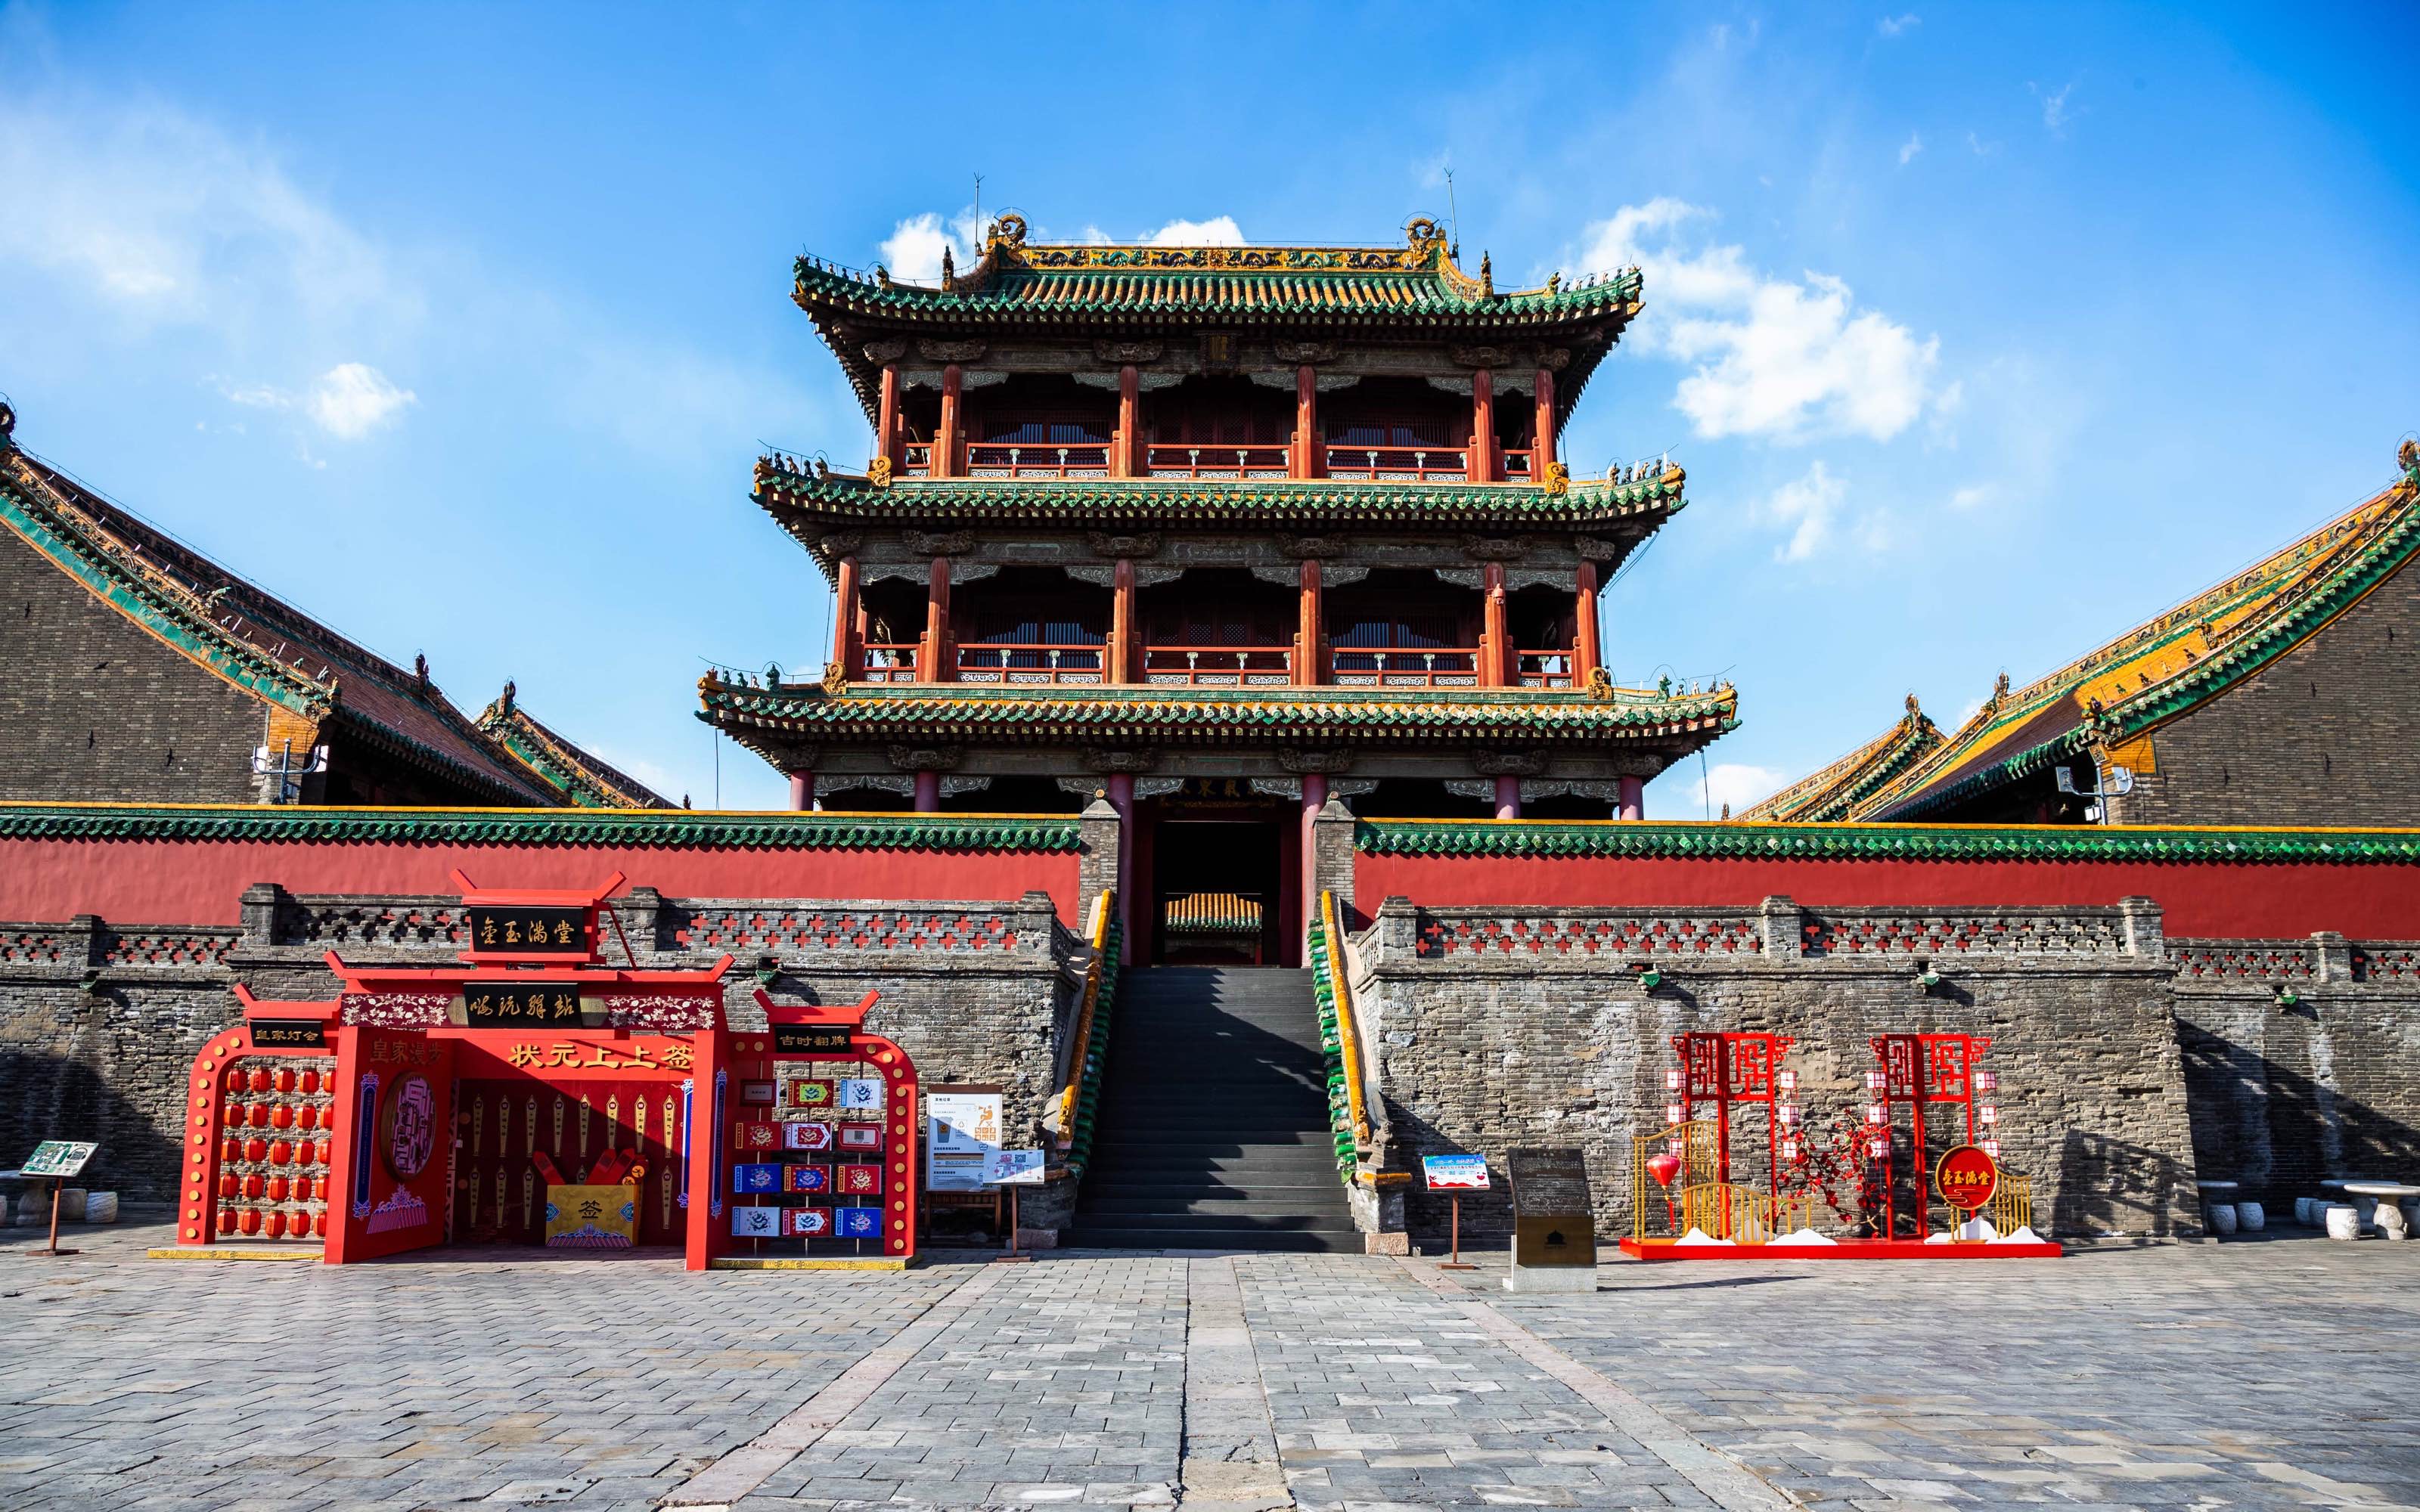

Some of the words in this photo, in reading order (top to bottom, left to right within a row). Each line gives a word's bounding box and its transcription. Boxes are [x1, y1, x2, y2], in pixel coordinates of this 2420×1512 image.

[255, 1030, 319, 1041] 皇家灯会
[779, 1035, 846, 1046] 吉时翻牌
[370, 1037, 445, 1064] 皇家漫步
[507, 1044, 695, 1070] 状元上上签
[1943, 1168, 1990, 1185] 金玉满堂
[579, 1200, 603, 1219] 签
